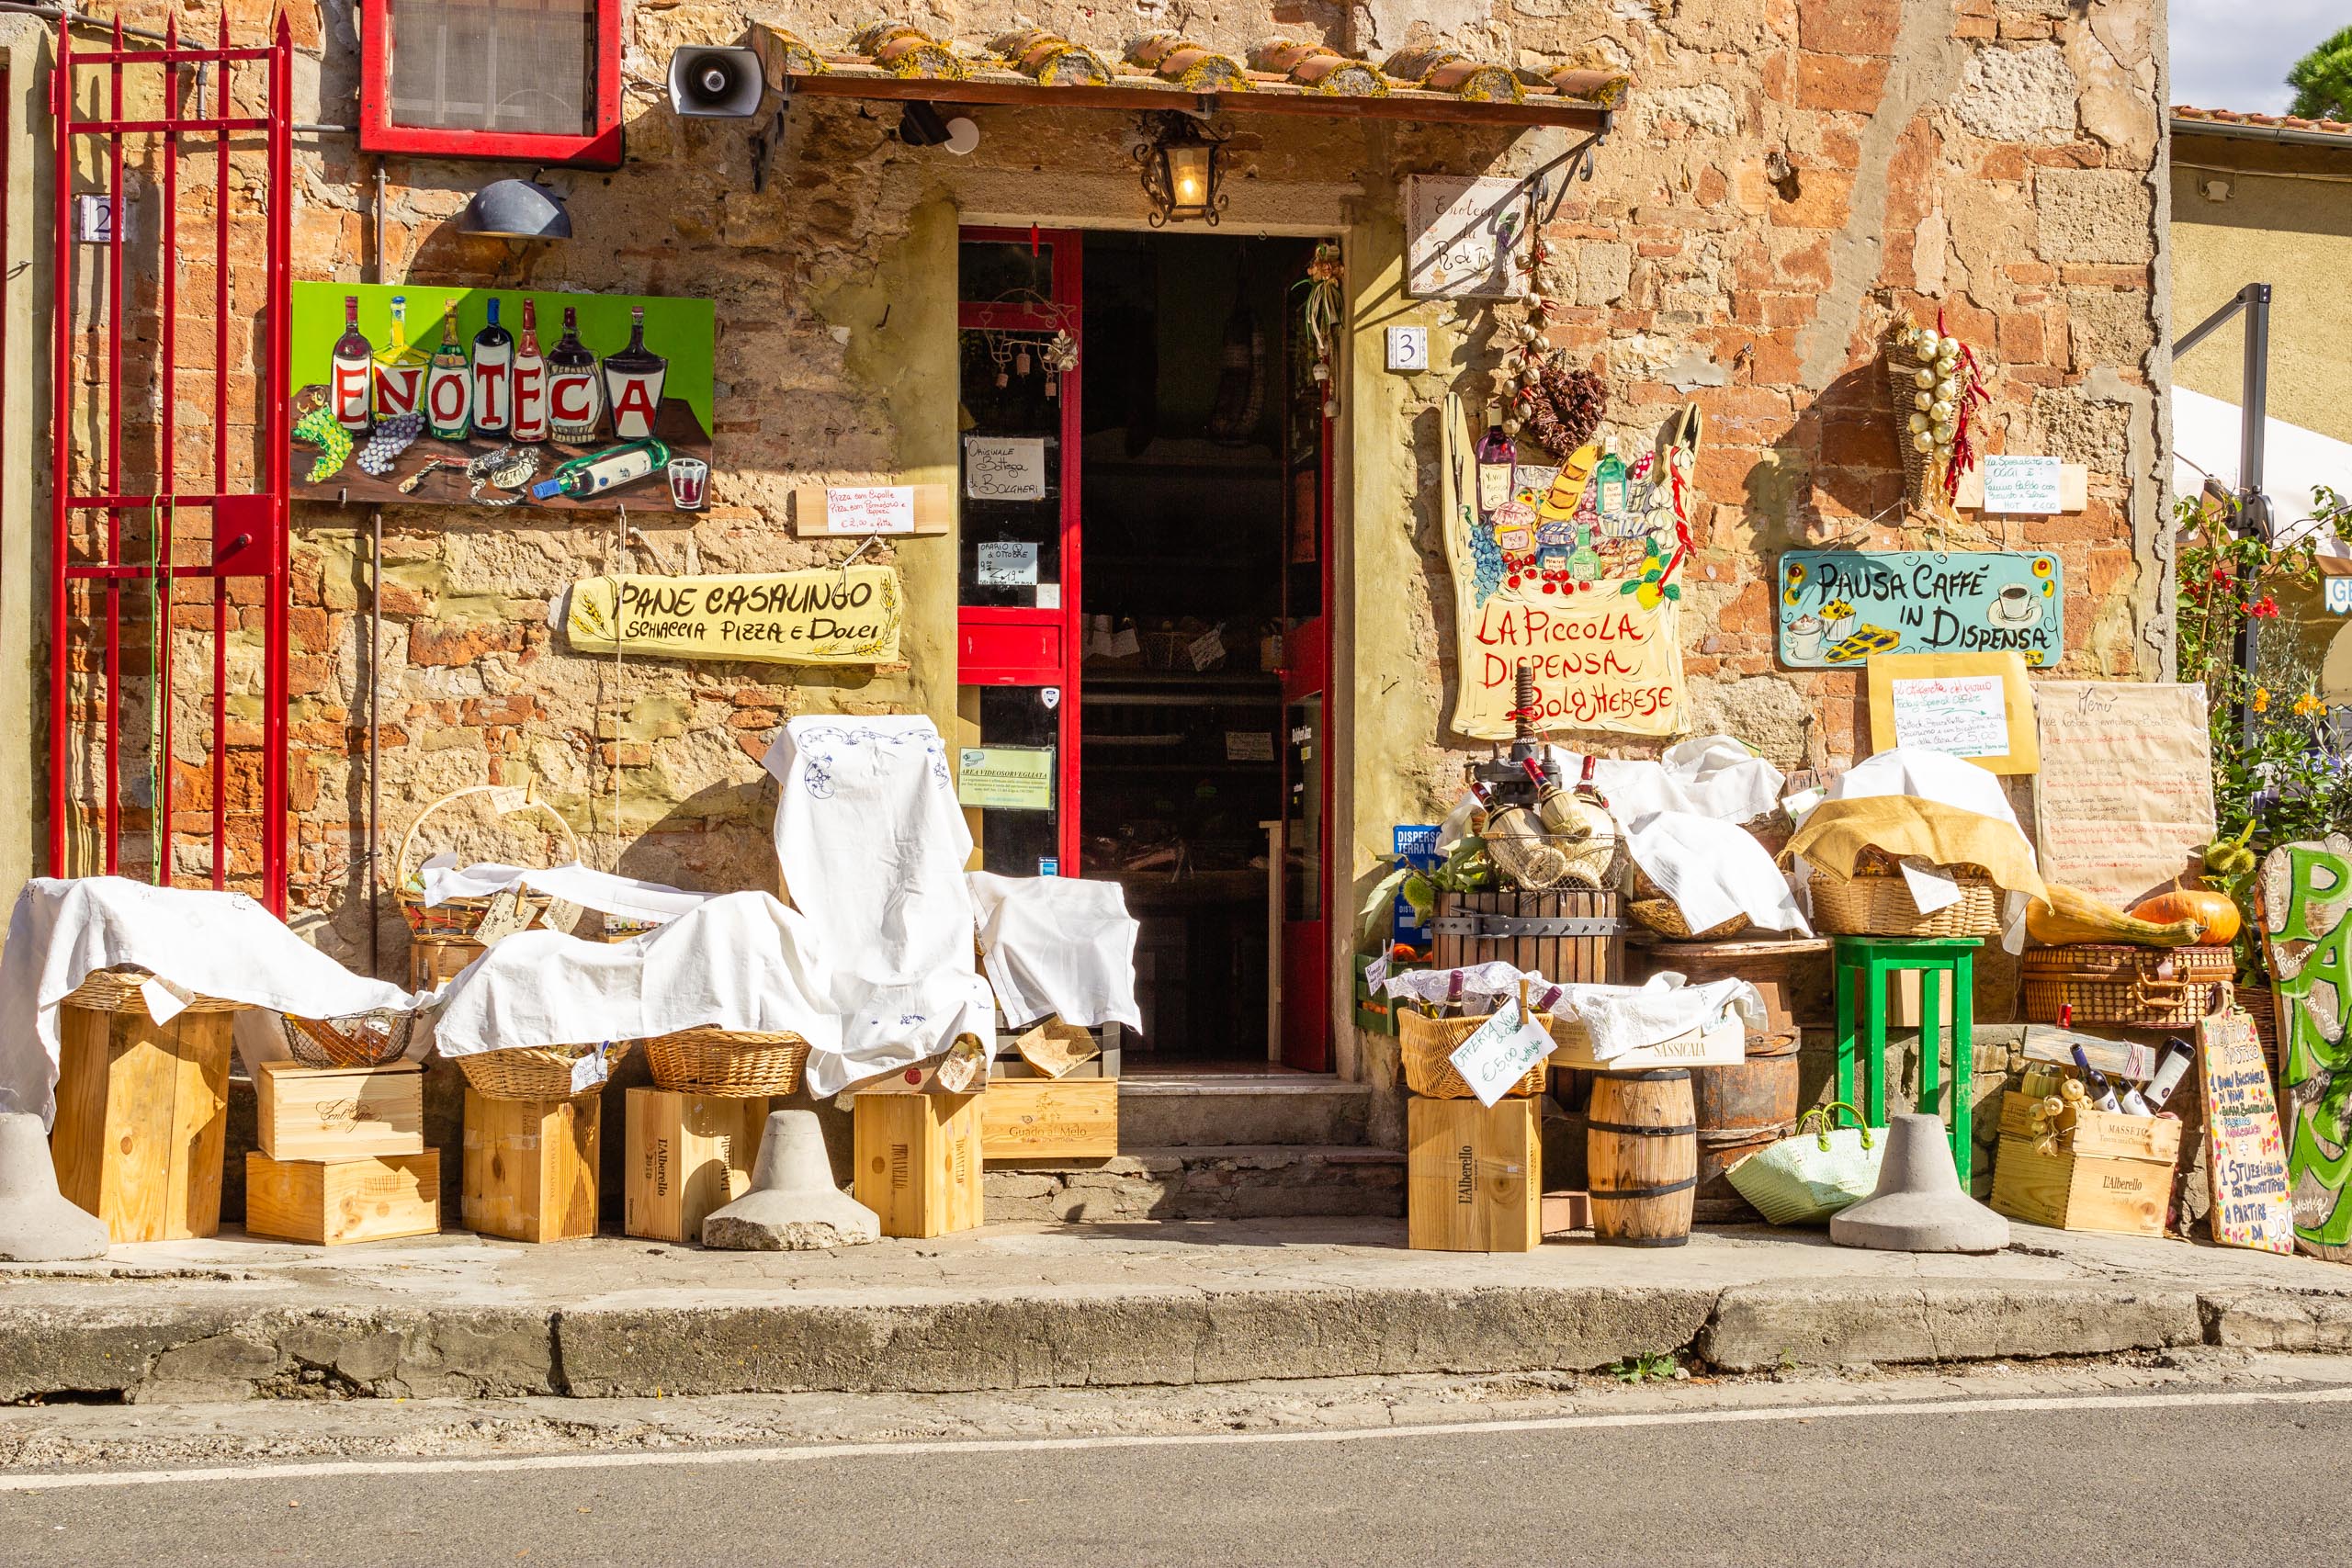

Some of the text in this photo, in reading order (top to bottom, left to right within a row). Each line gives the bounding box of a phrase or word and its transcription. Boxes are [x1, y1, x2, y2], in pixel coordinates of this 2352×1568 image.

[94, 205, 111, 232] 2
[1400, 334, 1416, 363] 3
[335, 362, 655, 431] ENOTECA
[978, 474, 1038, 494] BOLGHERI
[1817, 563, 1907, 605] PAUSA
[612, 581, 872, 619] PANE CASALINGO
[1475, 603, 1518, 646] LA
[1900, 605, 1924, 626] IN
[1920, 606, 2051, 652] DISPENSA
[626, 621, 707, 641] SCHIACCIA
[721, 620, 786, 643] PIZZA
[1397, 842, 1425, 854] TERRA
[2274, 942, 2317, 976] PROSCIUTTO
[1453, 1021, 1498, 1067] OFFERTA
[1654, 1043, 1705, 1057] SASSICAIA
[1009, 1126, 1045, 1138] Guado
[1060, 1125, 1087, 1138] Melo
[2108, 1123, 2148, 1136] MASSETO
[658, 1138, 669, 1198] L'Alberello
[1458, 1145, 1473, 1205] L'Alberello
[2103, 1175, 2143, 1191] L'Alberello
[2251, 1224, 2264, 1241] DA
